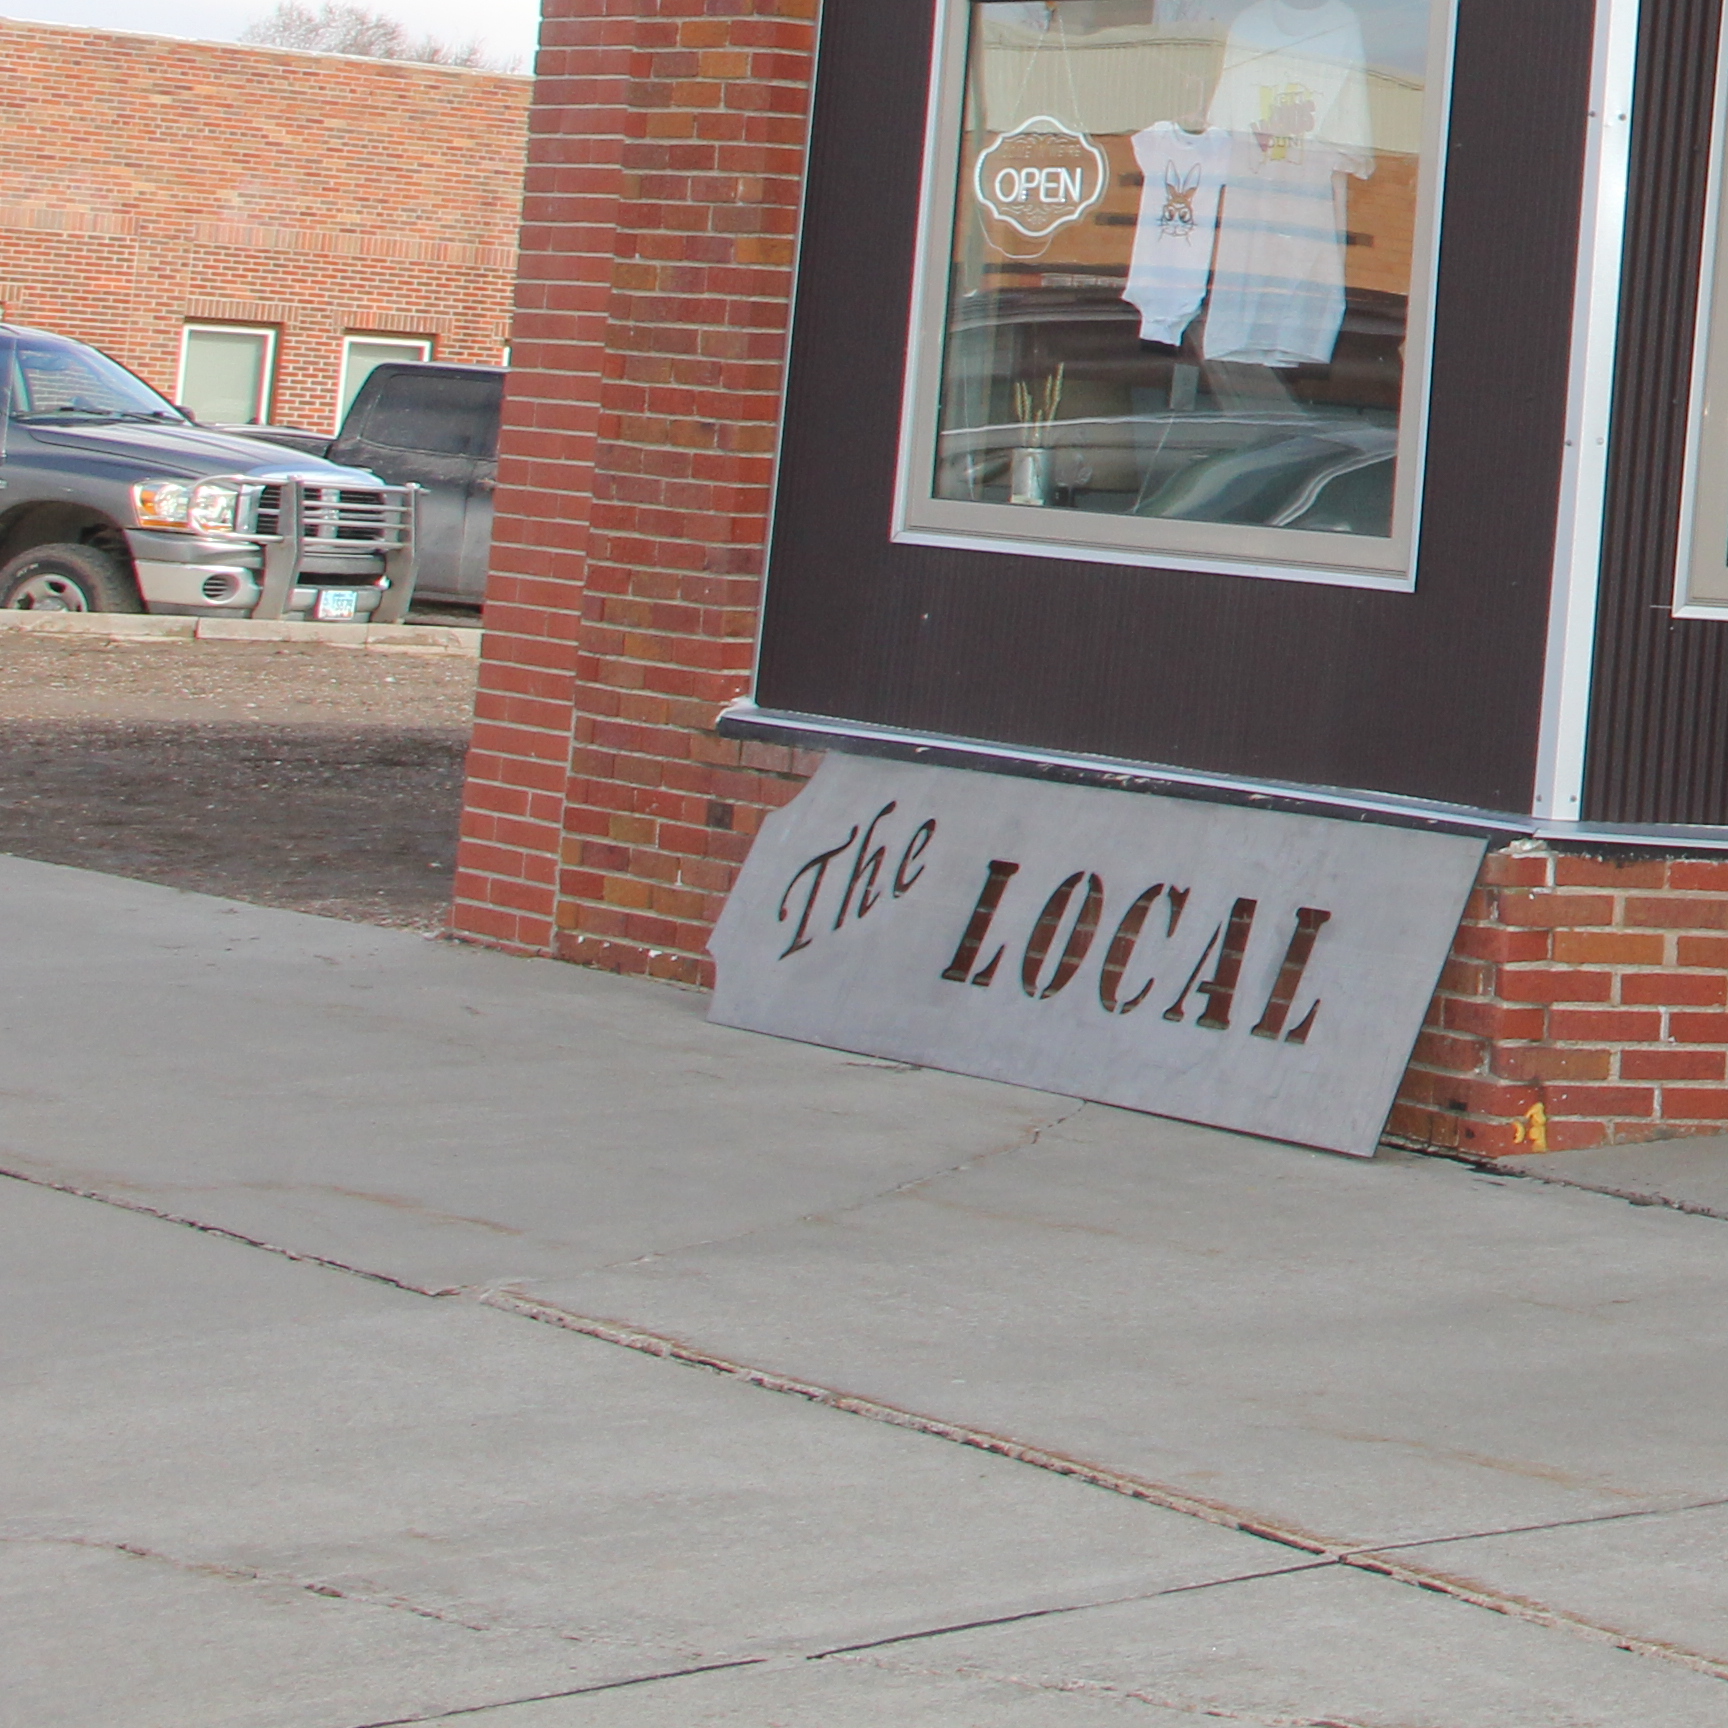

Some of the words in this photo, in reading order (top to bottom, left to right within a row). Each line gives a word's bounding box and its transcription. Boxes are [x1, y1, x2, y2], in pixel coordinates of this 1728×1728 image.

[994, 166, 1083, 204] OPEN
[777, 800, 937, 961] The
[941, 858, 1332, 1045] LOCAL
